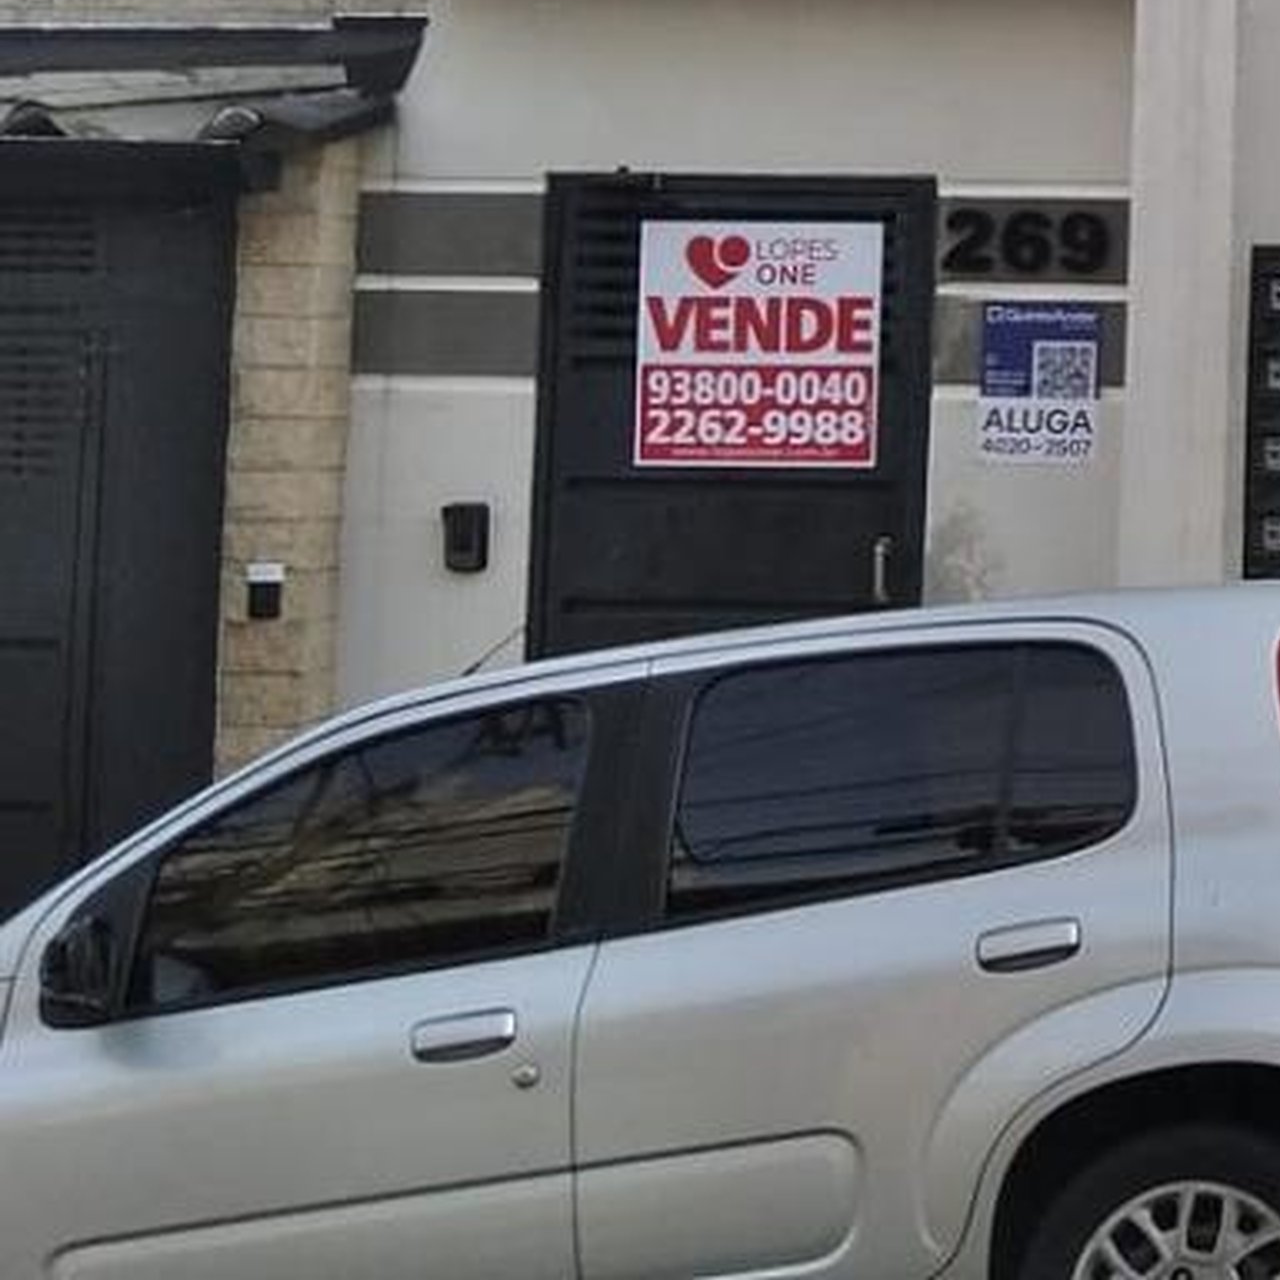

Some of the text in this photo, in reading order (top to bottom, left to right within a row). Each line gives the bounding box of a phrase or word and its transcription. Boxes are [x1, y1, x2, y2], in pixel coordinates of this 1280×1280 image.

[755, 238, 840, 261] LOPES
[942, 208, 1110, 273] 269
[756, 263, 816, 285] ONE
[645, 296, 873, 352] VENDE
[648, 370, 867, 405] 93800-0040
[645, 408, 865, 445] 2262-9988
[982, 408, 1093, 434] ALUGA
